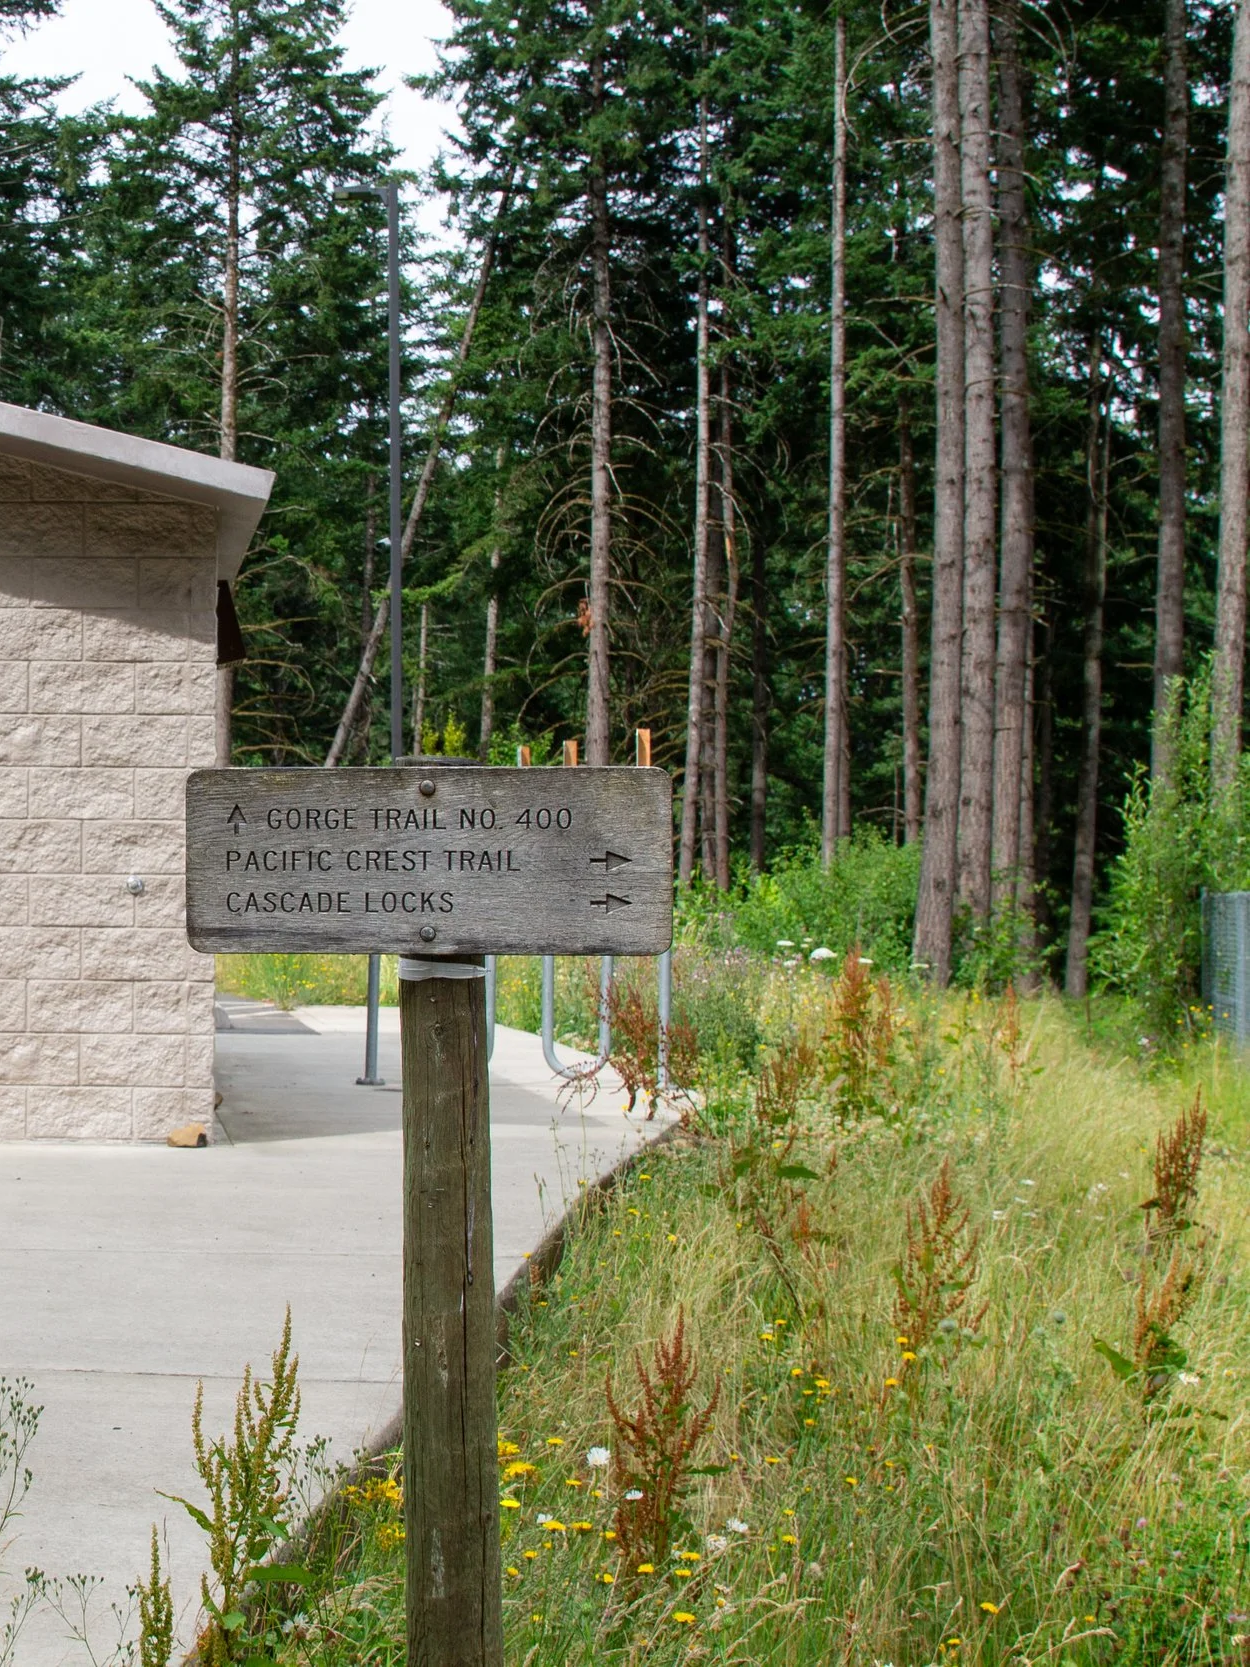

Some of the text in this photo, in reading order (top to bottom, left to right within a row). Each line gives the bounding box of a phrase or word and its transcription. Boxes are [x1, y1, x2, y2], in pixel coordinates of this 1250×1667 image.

[267, 808, 573, 830] GORGE TRAIL NO. 400
[226, 850, 521, 872] PACIFIC CREST TRAIL
[226, 892, 454, 913] CASCADE LOCKS
